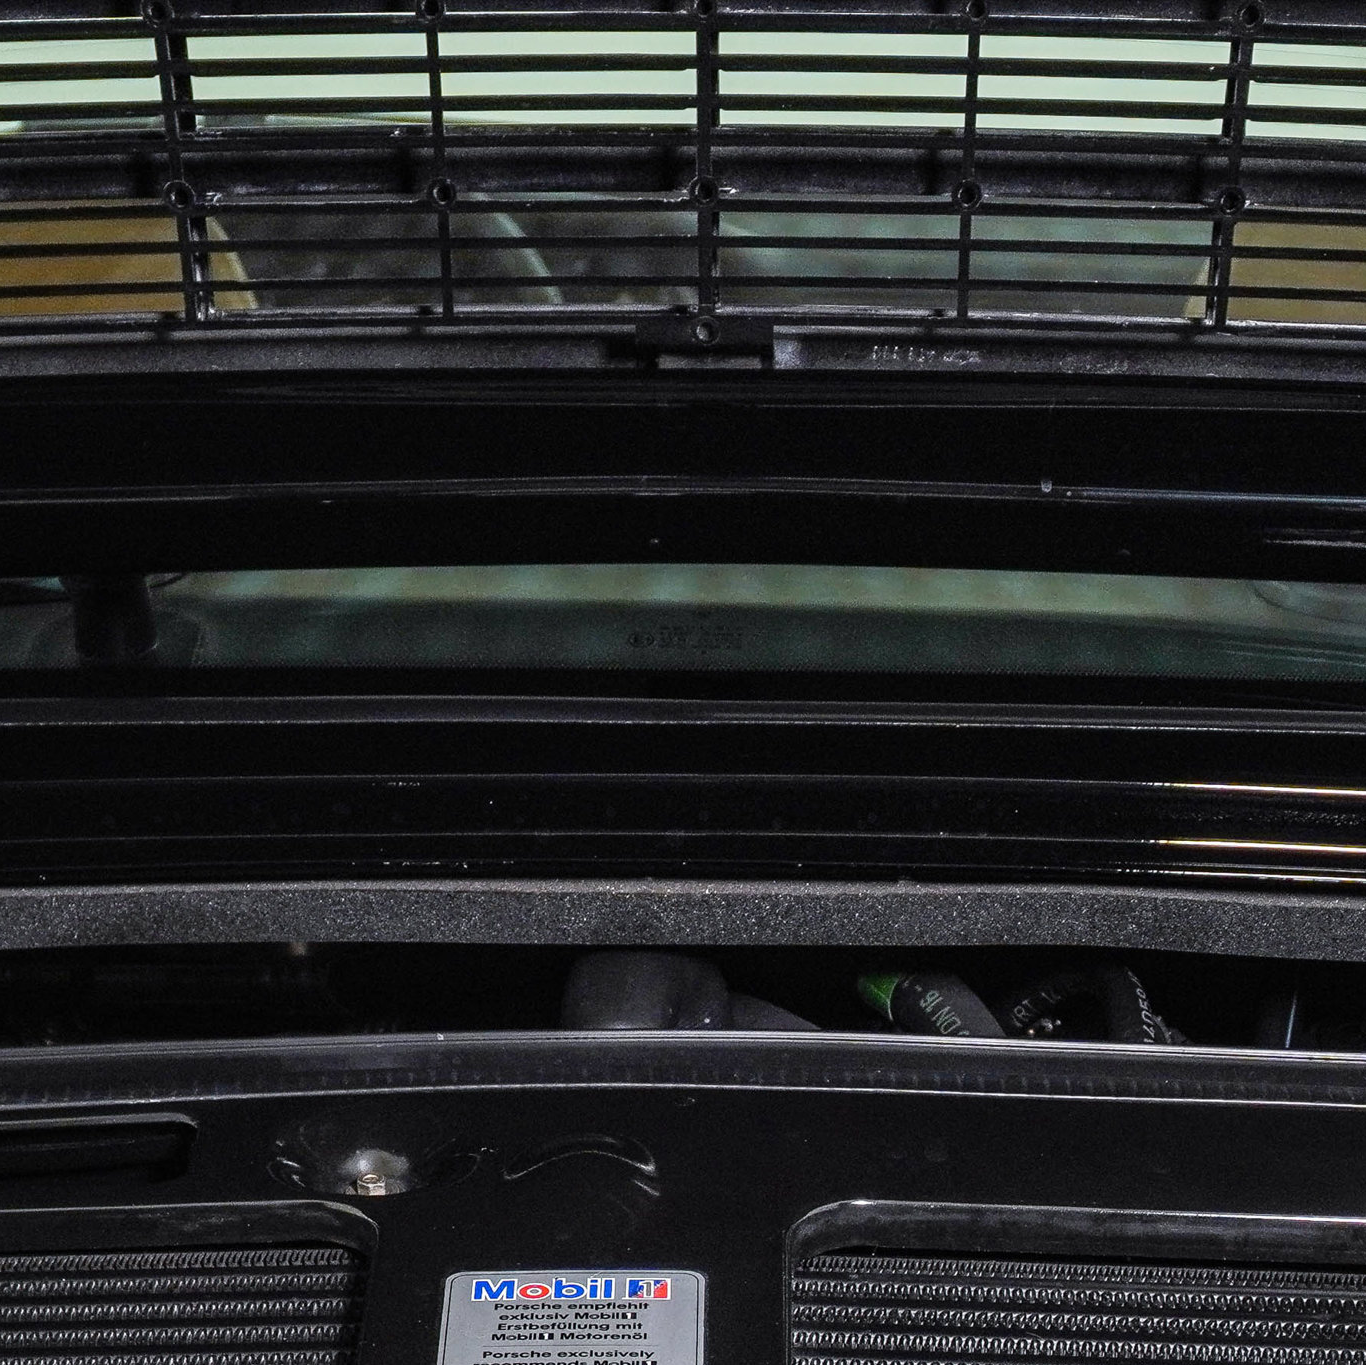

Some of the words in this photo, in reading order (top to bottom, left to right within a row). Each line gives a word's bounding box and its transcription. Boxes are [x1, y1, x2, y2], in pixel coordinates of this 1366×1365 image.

[473, 1278, 614, 1300] Mobil
[494, 1302, 562, 1311] Porsche
[567, 1301, 650, 1311] empfiehlt
[499, 1312, 570, 1321] exklusiv
[497, 1322, 610, 1332] Erstbefüllung
[615, 1322, 643, 1330] mit
[560, 1332, 648, 1340] Motorenöl
[482, 1350, 552, 1359] Porsche
[557, 1349, 655, 1360] exclusively
